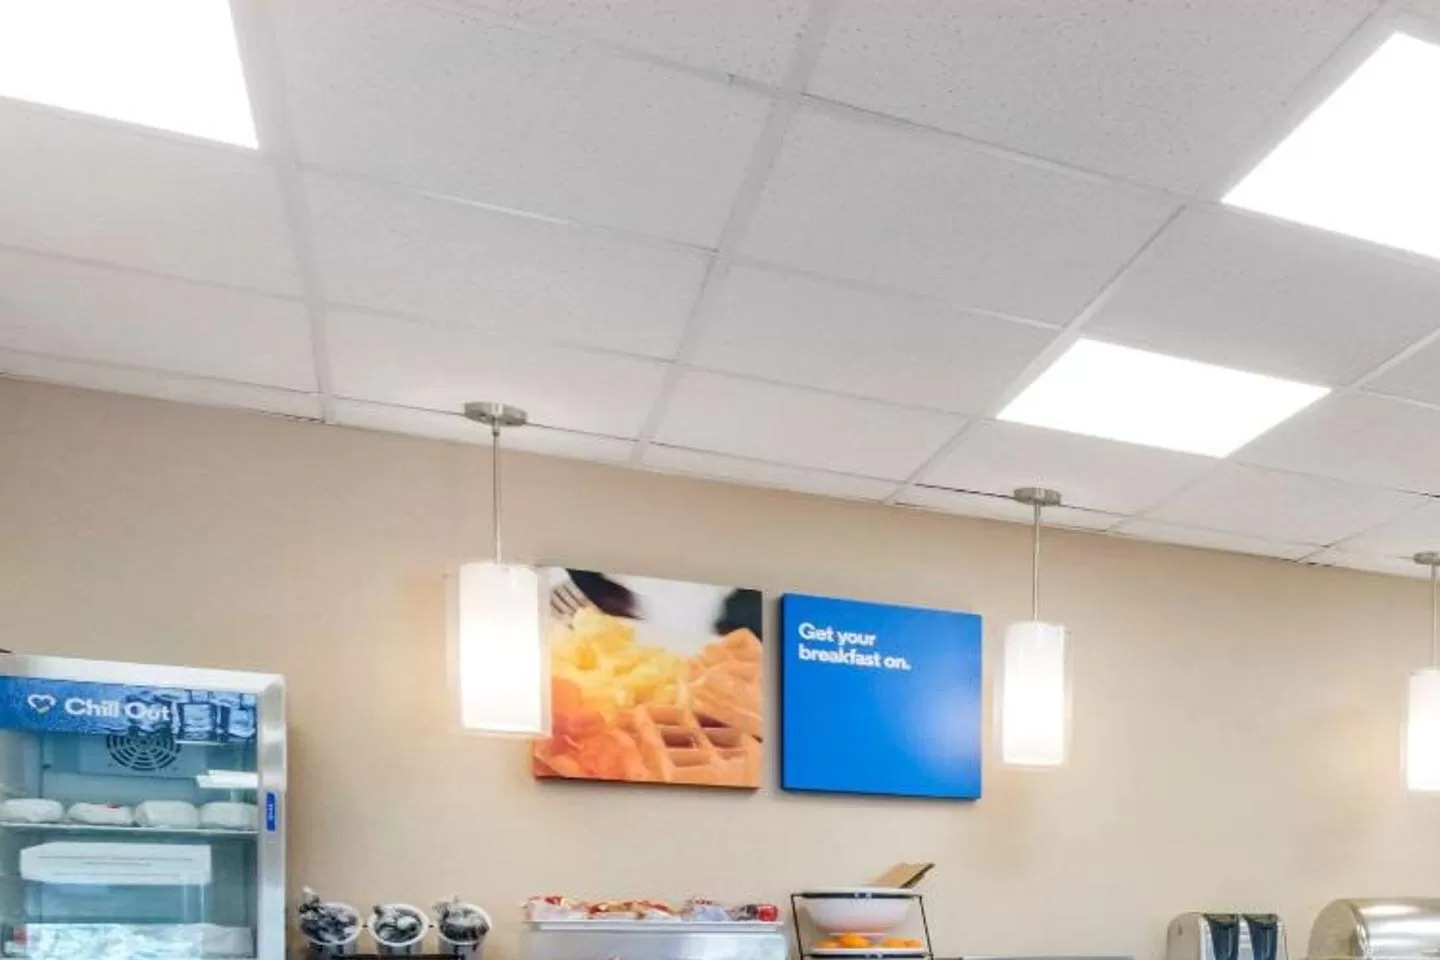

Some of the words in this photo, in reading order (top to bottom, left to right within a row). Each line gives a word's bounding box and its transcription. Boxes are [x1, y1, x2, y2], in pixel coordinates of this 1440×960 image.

[798, 622, 835, 642] Get
[836, 632, 876, 646] your
[798, 643, 882, 667] breakfast
[884, 655, 911, 671] on.
[64, 697, 119, 718] Chill
[124, 701, 170, 721] Out
